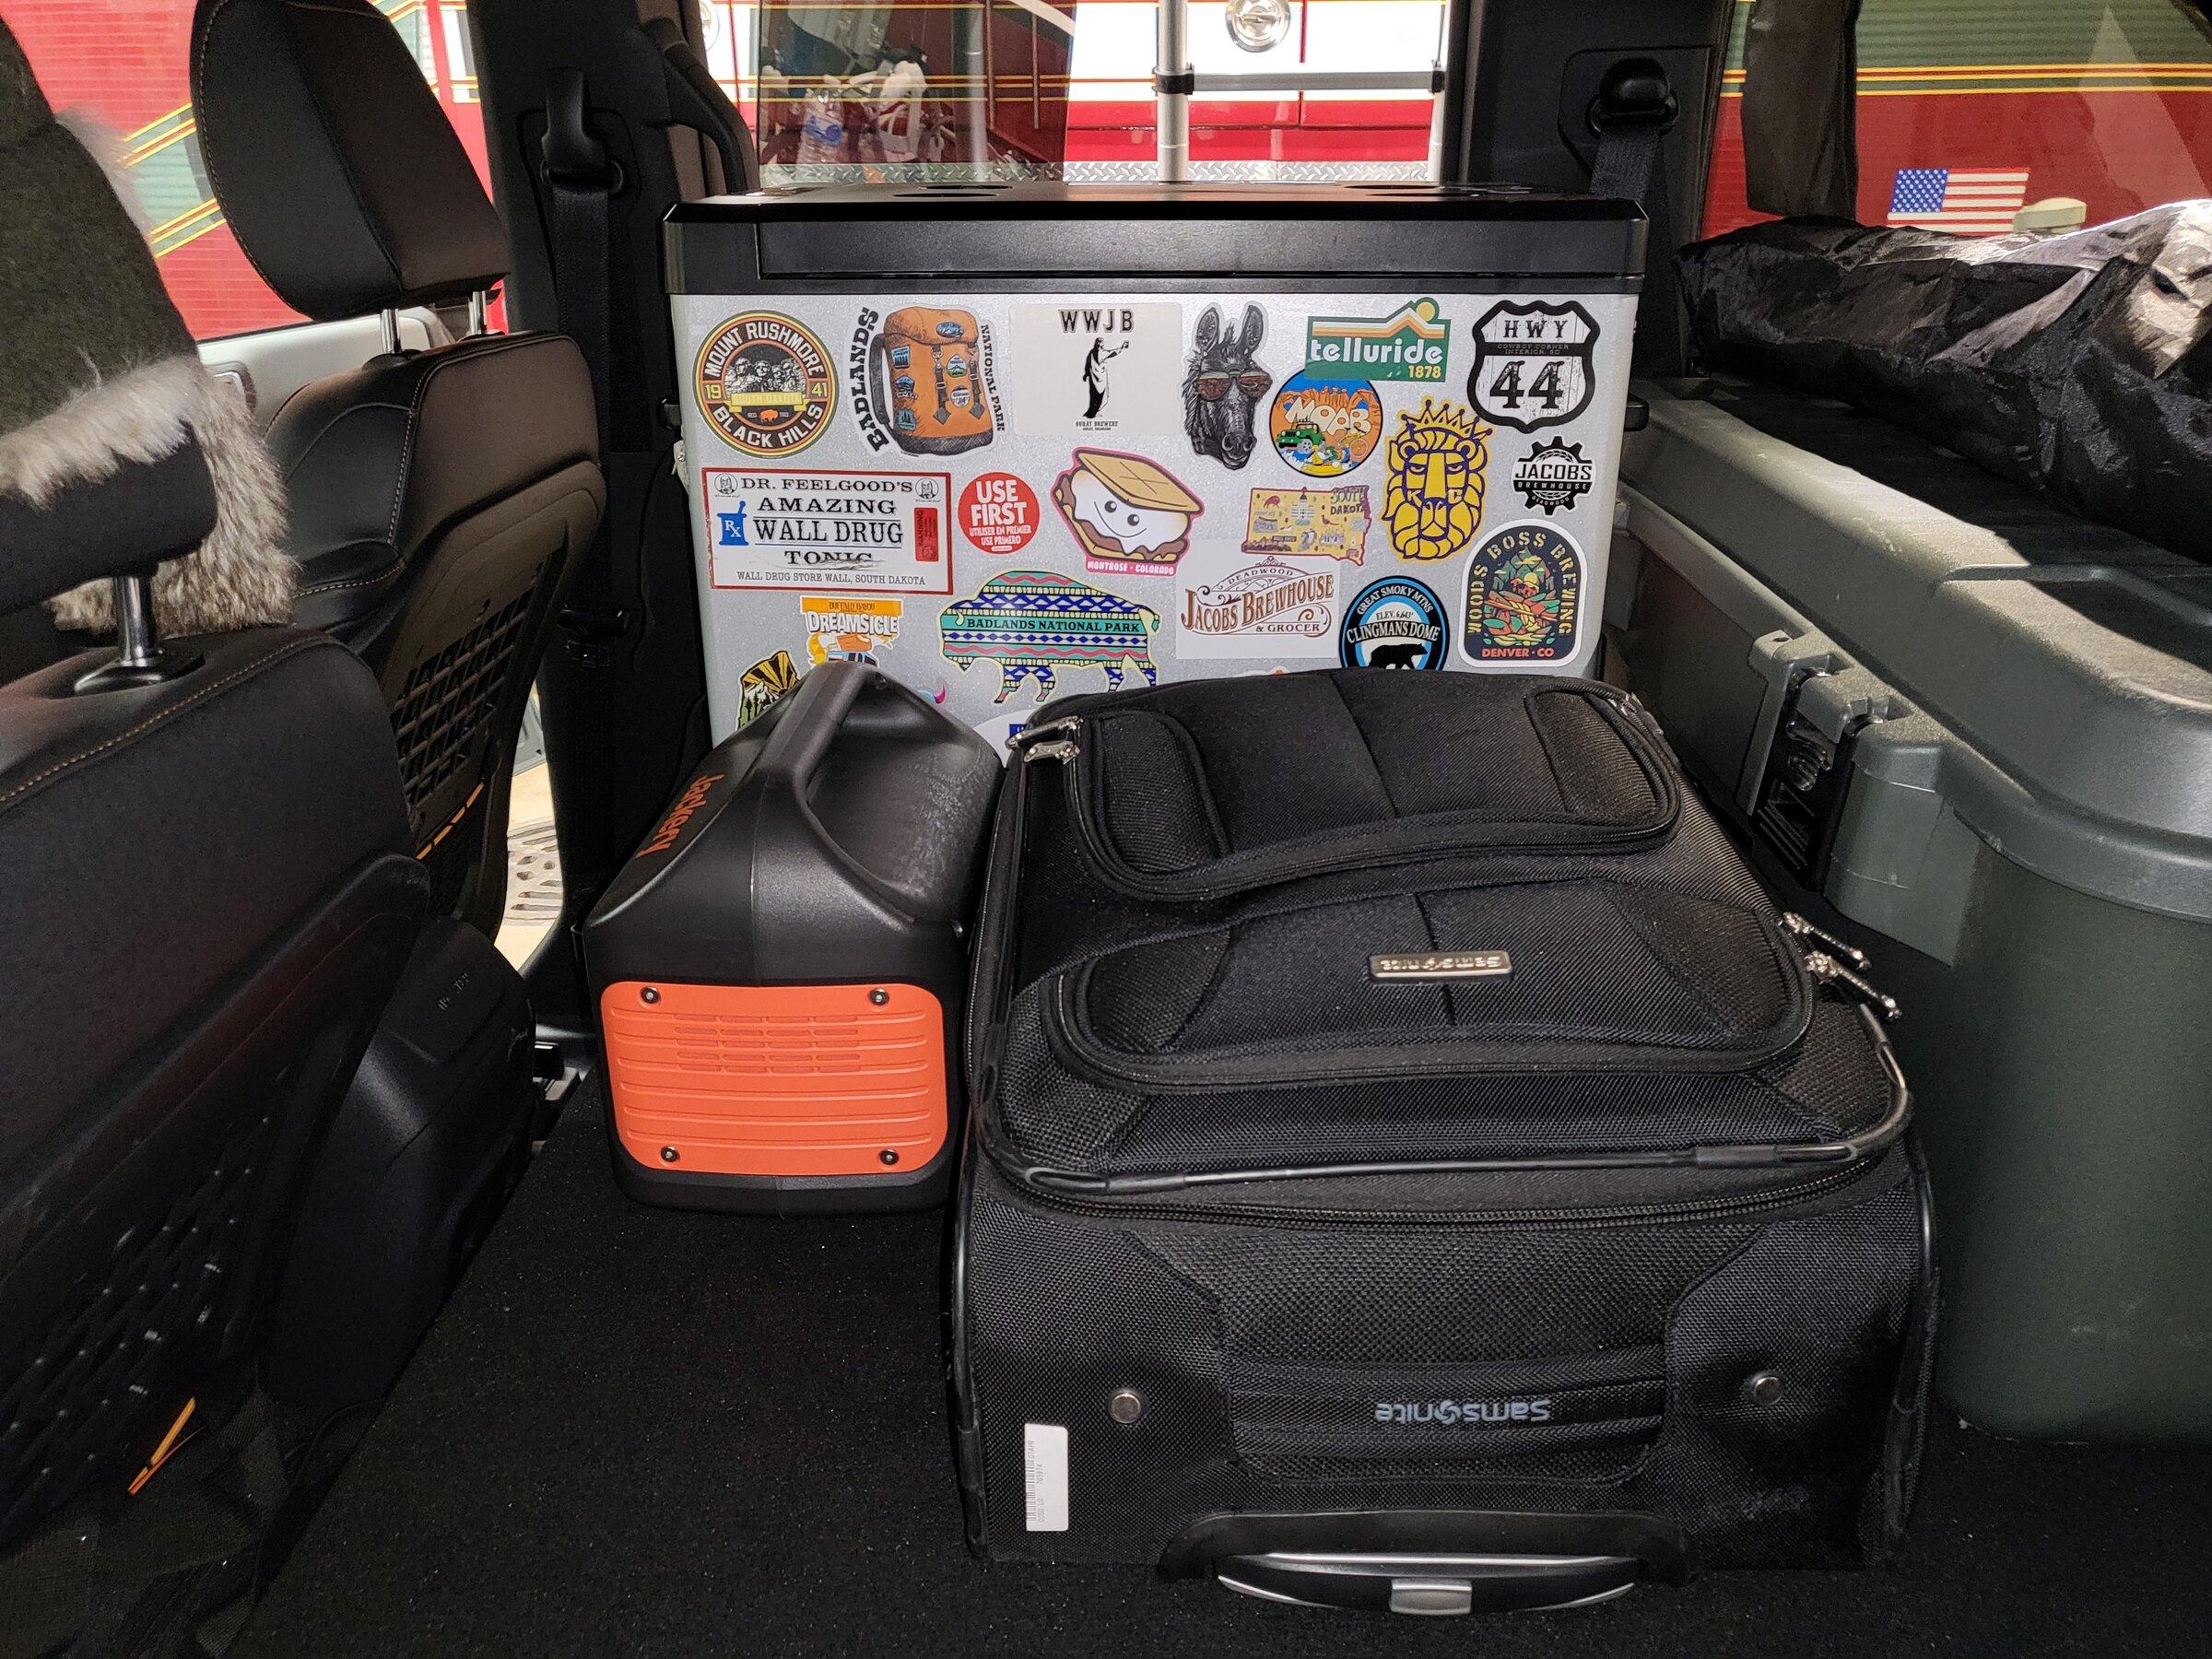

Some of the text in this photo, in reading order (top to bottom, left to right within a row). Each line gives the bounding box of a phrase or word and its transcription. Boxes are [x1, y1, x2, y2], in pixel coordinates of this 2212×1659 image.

[1058, 309, 1135, 333] WWJB
[1503, 320, 1568, 338] HWY
[704, 322, 824, 377] MOUNT RUSHMORE
[1311, 337, 1443, 364] telluride
[850, 307, 889, 452] BADLANDS
[981, 324, 1006, 431] NATIONAL PARK
[1408, 365, 1441, 379] 1878
[705, 384, 722, 399] 19
[811, 382, 828, 397] 41
[1489, 360, 1565, 408] 44
[1285, 396, 1371, 436] MOAB
[713, 405, 823, 448] BLACK HILLS
[1515, 464, 1592, 480] JACOBS
[741, 477, 912, 493] DR. FEELGOOD'S
[976, 479, 1018, 503] USE
[757, 497, 897, 514] AMAZING
[971, 502, 1028, 526] FIRST
[753, 520, 827, 542] WALL
[834, 521, 903, 544] DRUG
[1006, 524, 1031, 535] PREMIER
[982, 535, 1021, 546] USE PRIMERO
[1088, 560, 1174, 575] MONTROSE COLORADO
[1228, 568, 1293, 584] DEADWOOD
[737, 571, 925, 585] WALL DRUG STORE WALL, SOUTH DAKOTA
[1467, 532, 1577, 634] WOODS BOSS BREWING
[1181, 574, 1335, 633] JACOBS BREWHOUSE
[1357, 585, 1434, 615] GREAT SMOKY MTNS
[968, 618, 1139, 632] BADLANDS NATIONAL PARK
[1375, 610, 1395, 620] ELEV.
[1255, 623, 1320, 633] & GROCER
[1346, 621, 1441, 643] CLINGMANS DOME
[1481, 648, 1555, 657] DENVER CO
[1374, 1399, 1552, 1425] Samsonite
